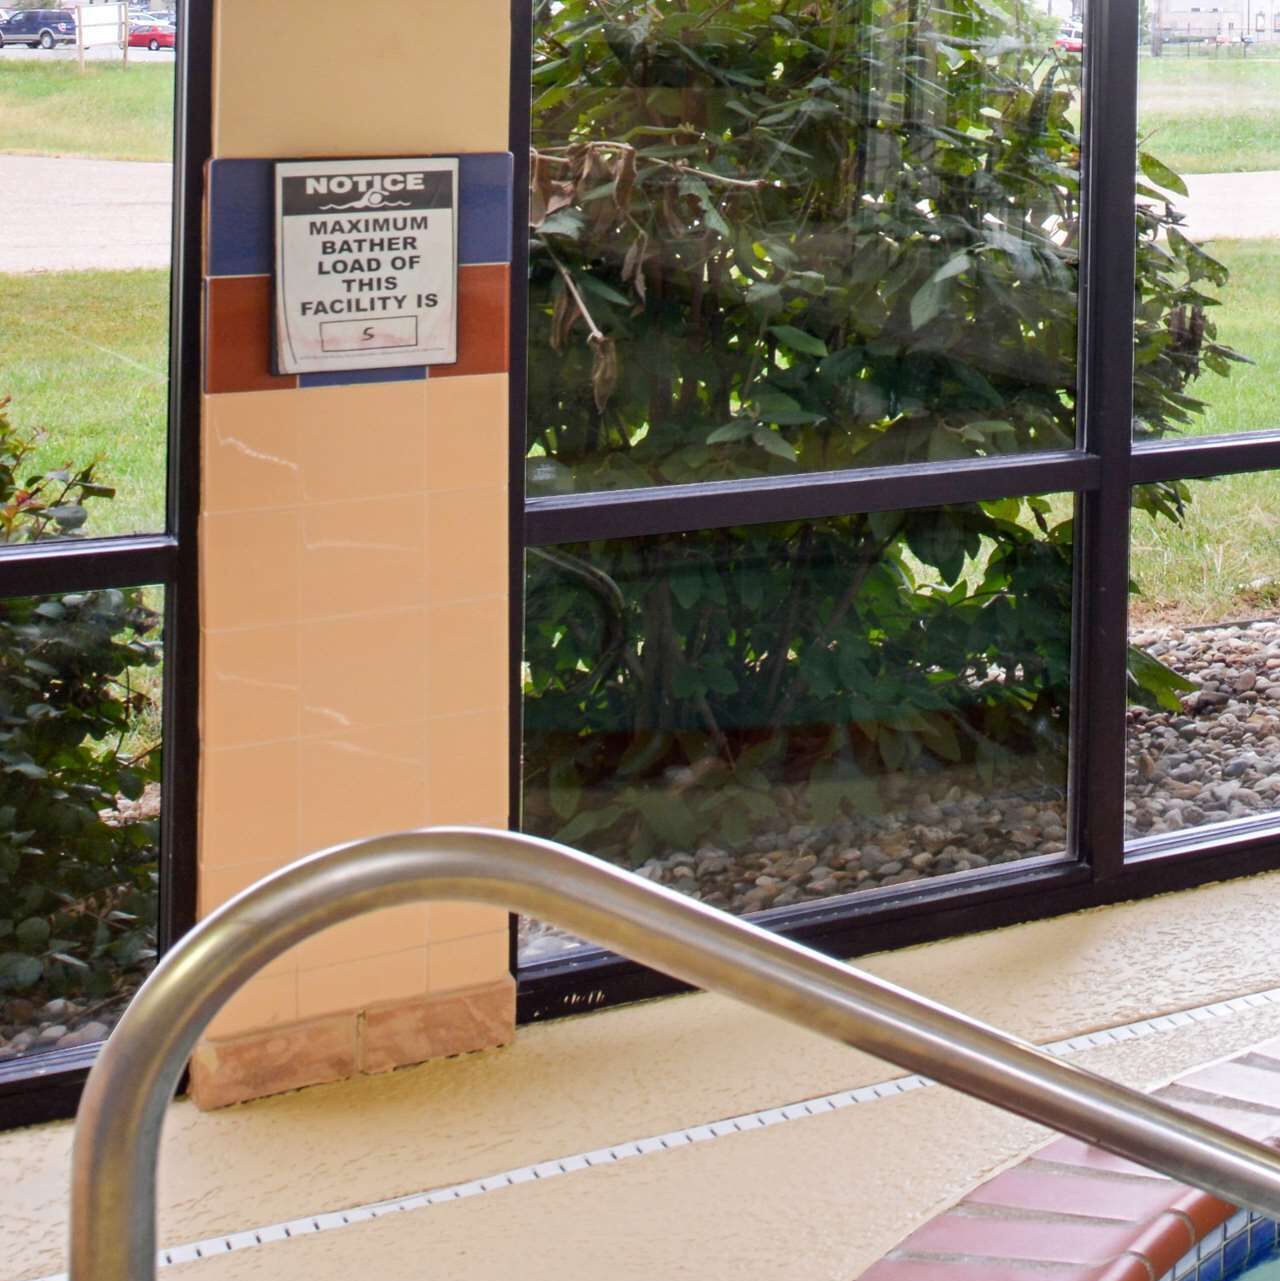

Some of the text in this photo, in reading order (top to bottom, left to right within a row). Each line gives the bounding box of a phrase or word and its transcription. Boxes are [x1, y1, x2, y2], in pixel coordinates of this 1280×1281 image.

[305, 173, 425, 195] NOTICE
[309, 215, 429, 236] MAXIMUM
[321, 236, 417, 255] BATHER
[318, 255, 421, 275] LOAD OF
[342, 276, 397, 293] THIS
[300, 293, 438, 316] FACILITY IS
